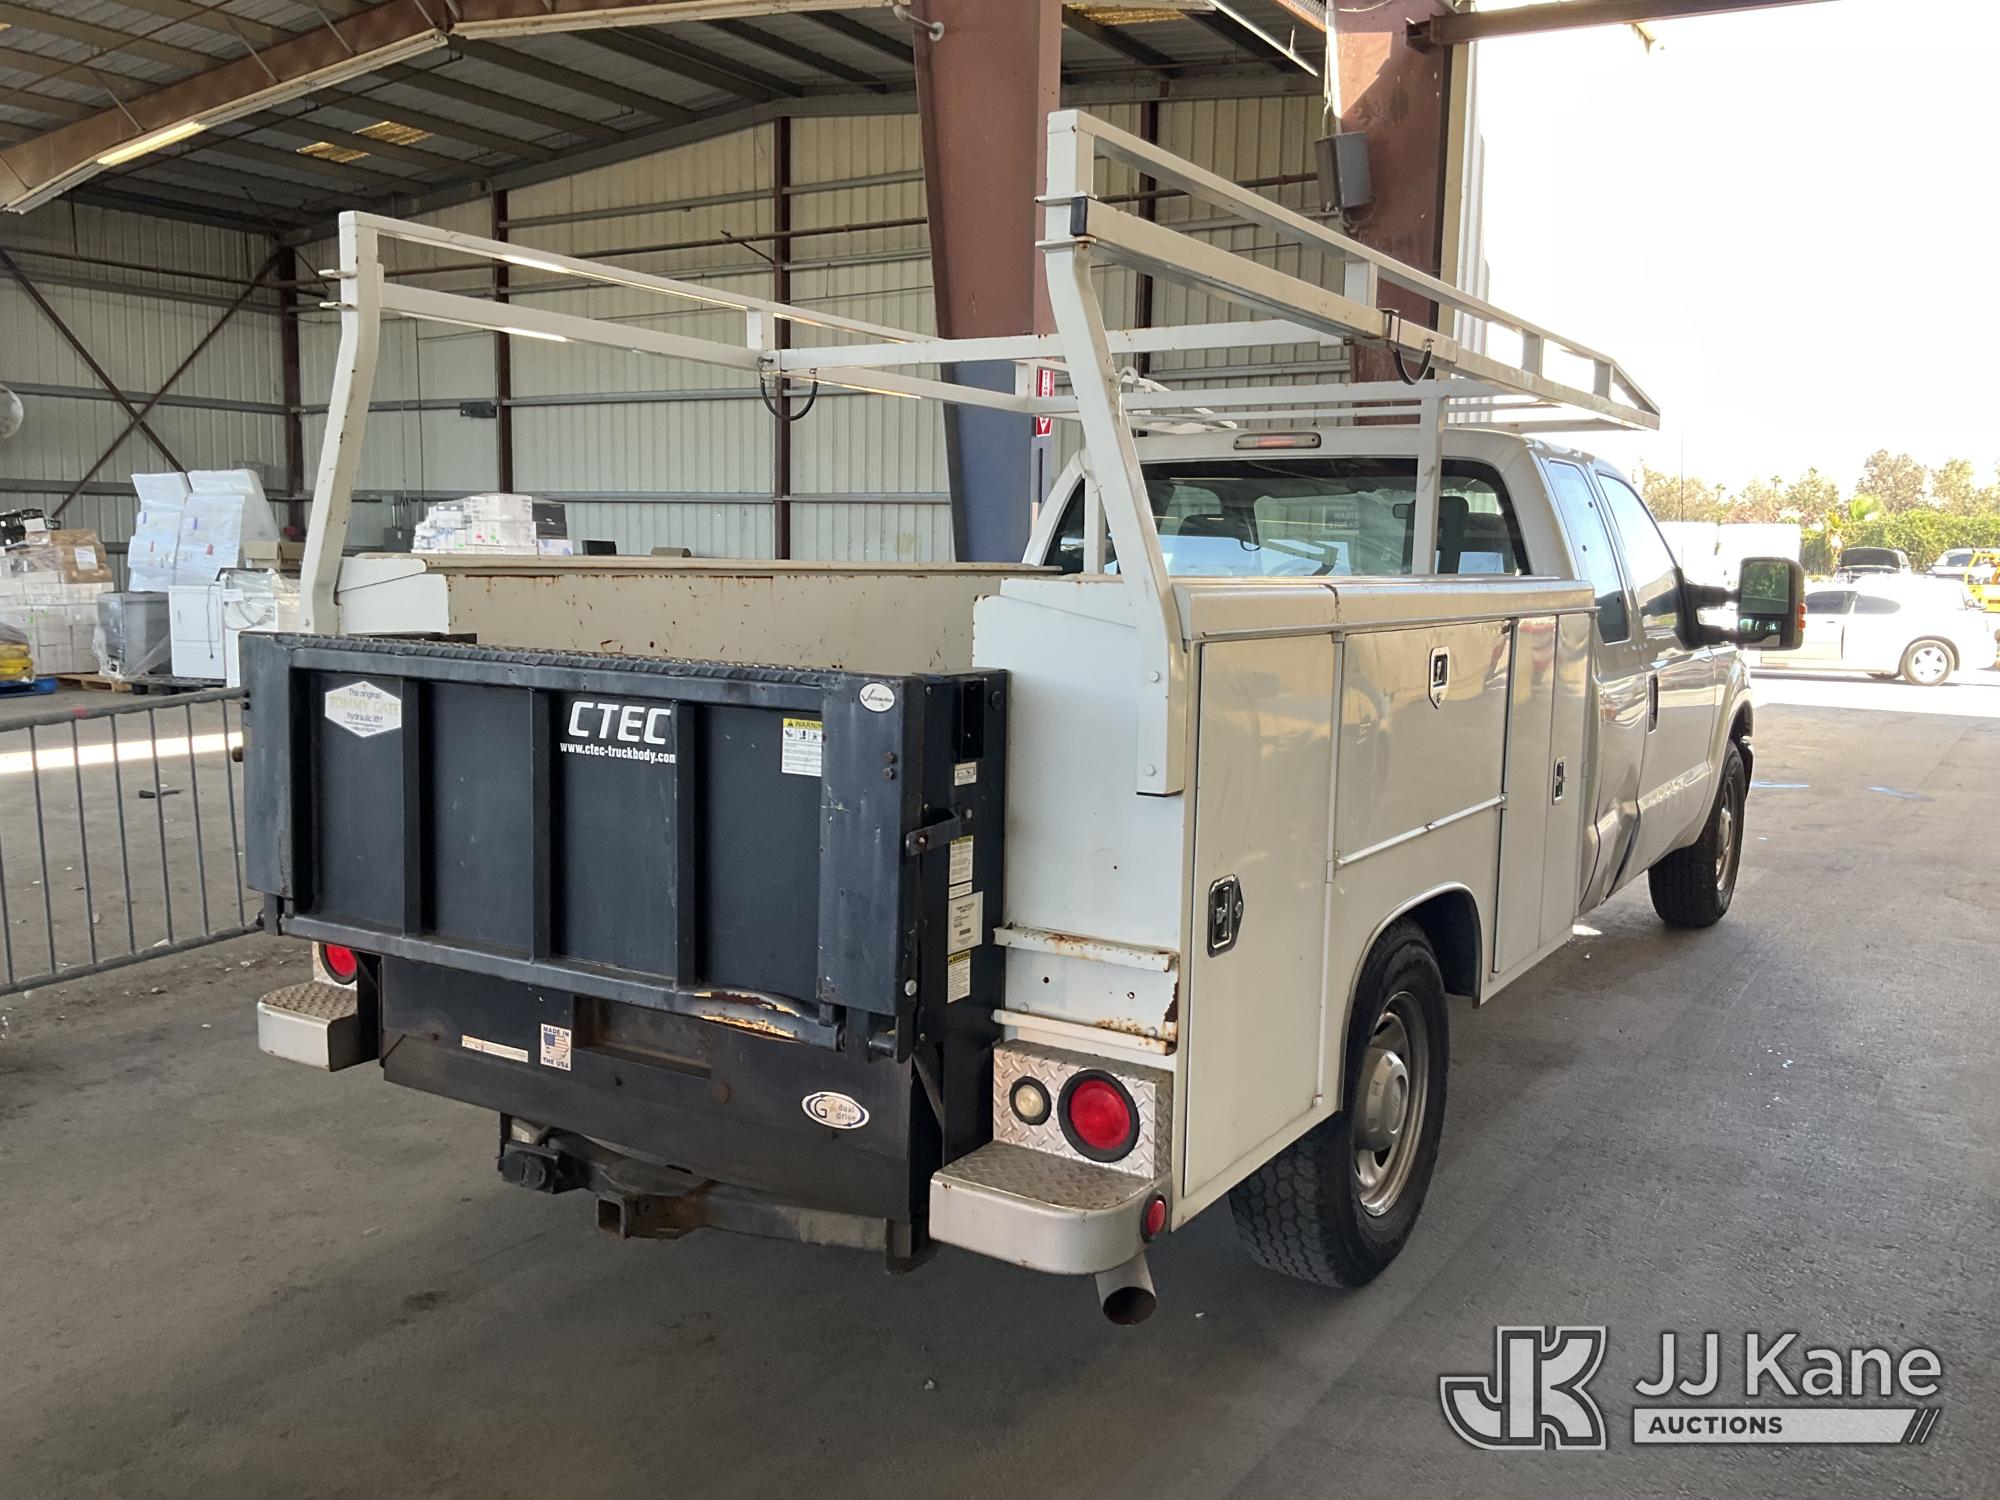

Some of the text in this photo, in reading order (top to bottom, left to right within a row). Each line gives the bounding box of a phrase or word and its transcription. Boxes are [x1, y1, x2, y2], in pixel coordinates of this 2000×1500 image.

[348, 687, 359, 697] The
[568, 701, 672, 745] CTEC
[543, 1025, 570, 1037] MADE IN
[542, 1057, 569, 1069] THE USA
[838, 1103, 855, 1113] dual
